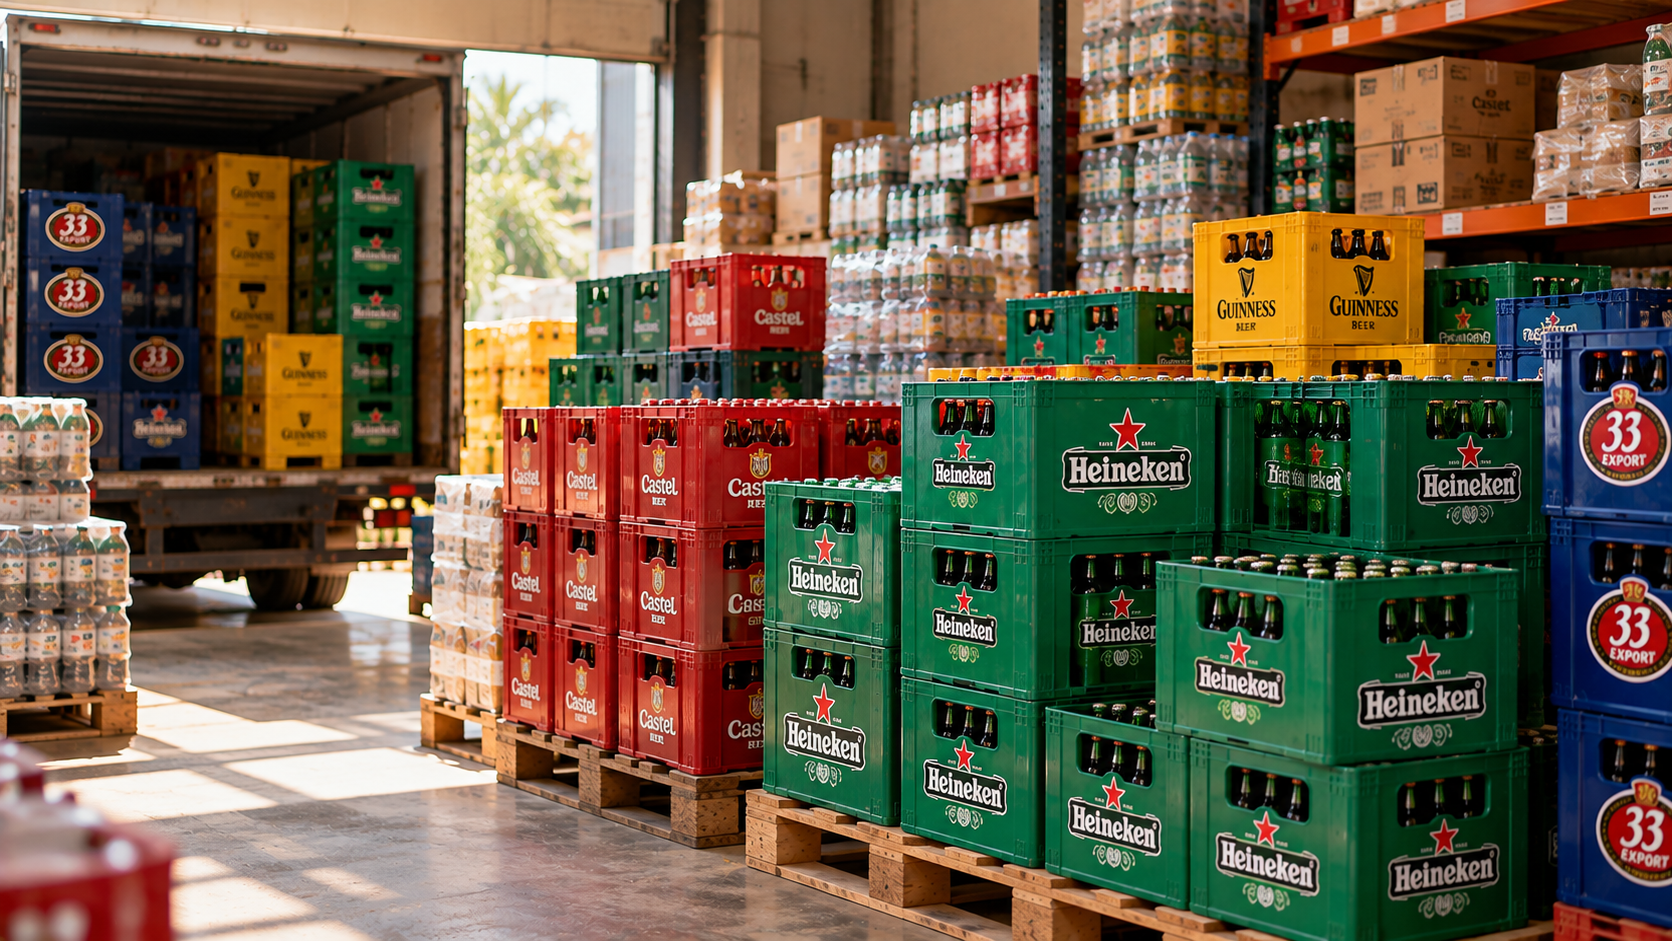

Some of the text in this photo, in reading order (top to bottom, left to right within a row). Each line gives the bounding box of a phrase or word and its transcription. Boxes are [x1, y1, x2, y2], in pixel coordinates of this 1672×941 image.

[59, 213, 88, 237] 33
[58, 279, 87, 302] 33
[754, 308, 804, 326] Castel
[1217, 298, 1276, 320] GUINNESS
[1329, 294, 1399, 318] GUINNESS
[1351, 320, 1376, 331] BEER
[57, 345, 86, 368] 33
[142, 346, 168, 368] 33
[1601, 410, 1643, 453] 33
[1069, 456, 1185, 484] Heineken
[1601, 453, 1647, 468] EXPORT
[512, 467, 541, 487] Castel
[566, 470, 598, 491] Castel
[641, 474, 678, 496] Castel
[935, 463, 992, 486] Heineken
[1424, 472, 1516, 498] Heineken
[727, 477, 765, 498] Cast
[511, 571, 541, 594] Castel
[791, 561, 859, 596] Heineken
[566, 580, 598, 603] Castel
[640, 591, 678, 615] Castel
[935, 616, 993, 642] Heineken
[1609, 604, 1652, 649] 33
[1609, 647, 1656, 665] EXPORT
[511, 677, 541, 701] Castel
[1199, 664, 1280, 701] Heineken
[566, 690, 598, 717] Castel
[1364, 685, 1480, 720] Heineken
[639, 709, 677, 736] Castel
[727, 719, 764, 740] Cas
[787, 720, 860, 762] Heineken
[927, 767, 1003, 808] Heineken
[1072, 807, 1156, 849] Heineken
[1619, 805, 1666, 852] 33
[1221, 841, 1314, 889] Heineken
[1620, 848, 1670, 870] EXPORT
[1394, 857, 1494, 892] Heineken
